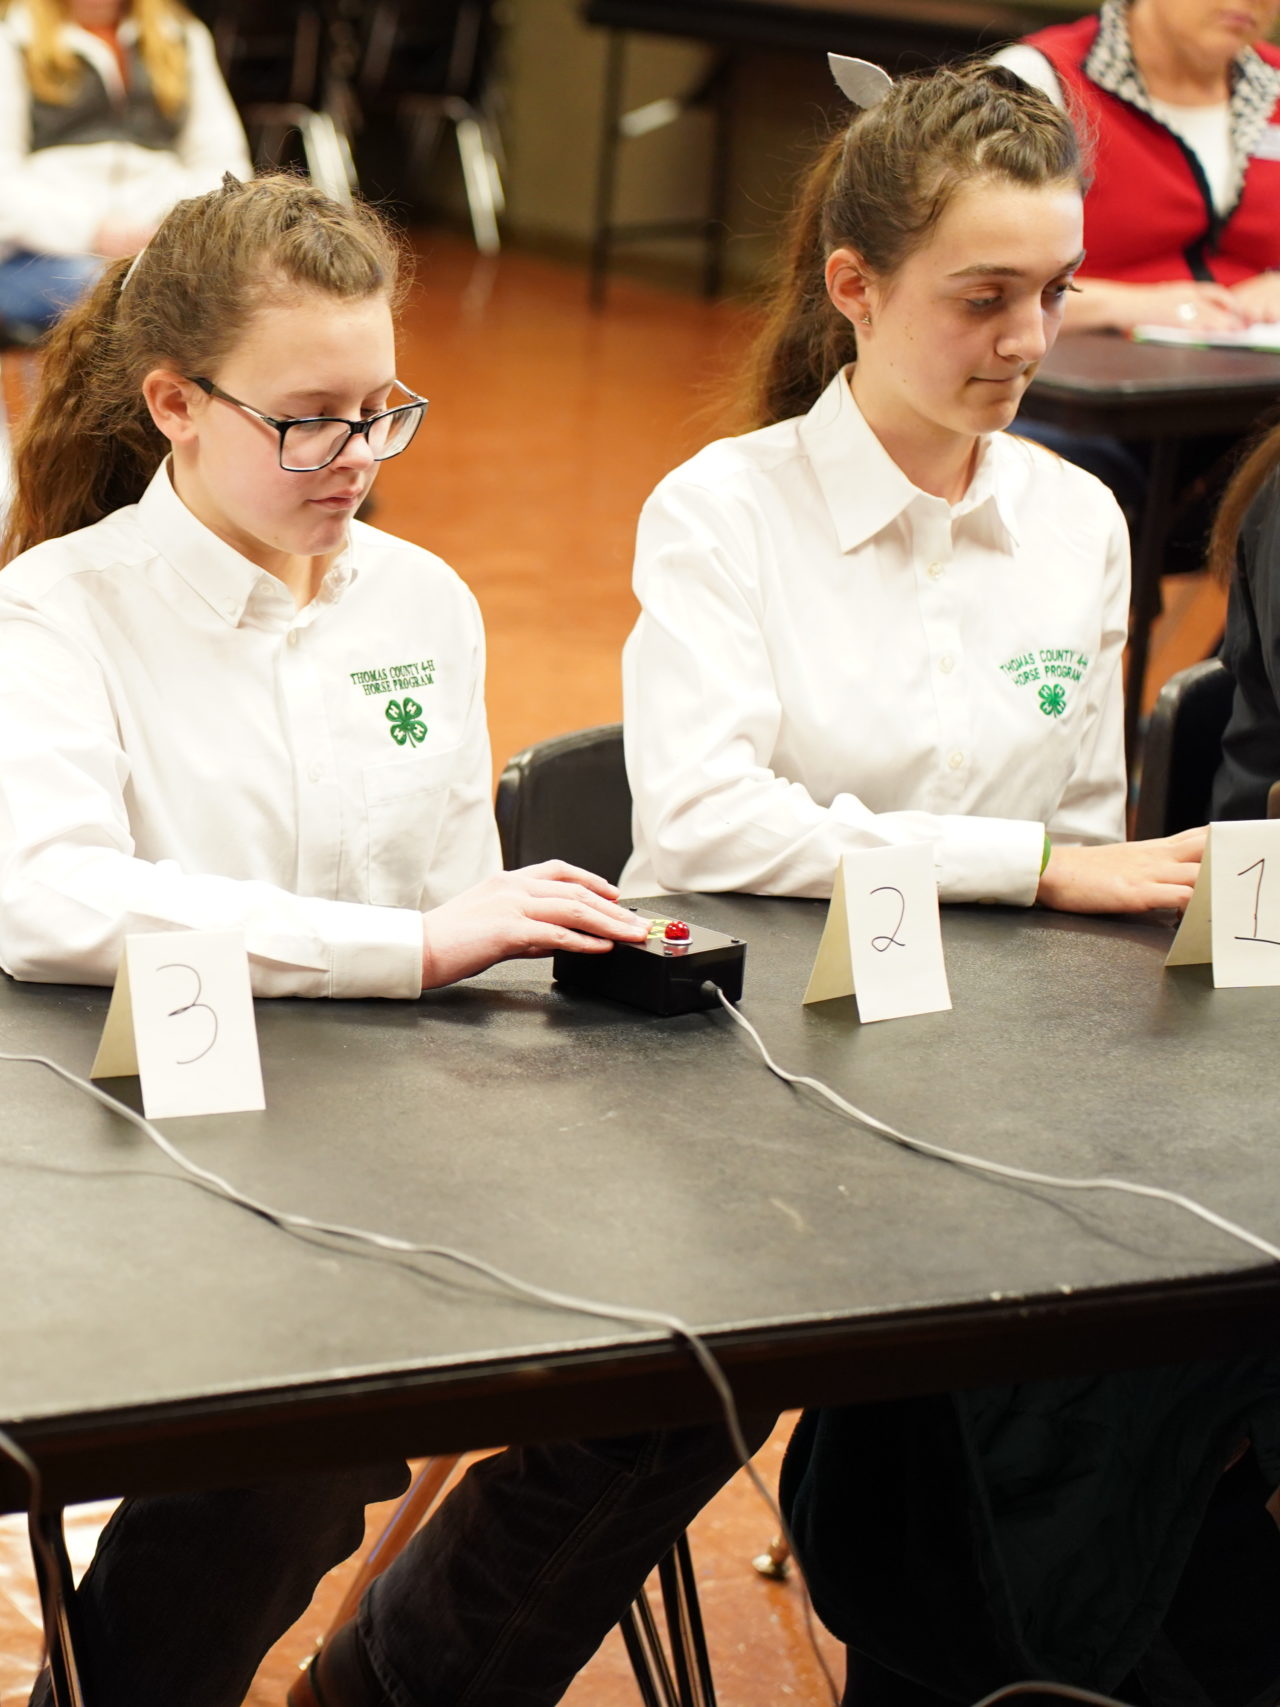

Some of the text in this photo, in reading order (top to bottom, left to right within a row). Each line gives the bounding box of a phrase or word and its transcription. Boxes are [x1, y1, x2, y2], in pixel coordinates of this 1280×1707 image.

[1039, 649, 1074, 663] COUNTY
[350, 667, 388, 685] THOMAS
[389, 663, 420, 679] COUNTY
[362, 673, 434, 696] HORSE PROGRAM
[1044, 665, 1083, 684] PROGRAM
[1234, 857, 1280, 945] 1
[869, 886, 907, 953] 2
[155, 963, 218, 1065] 3
